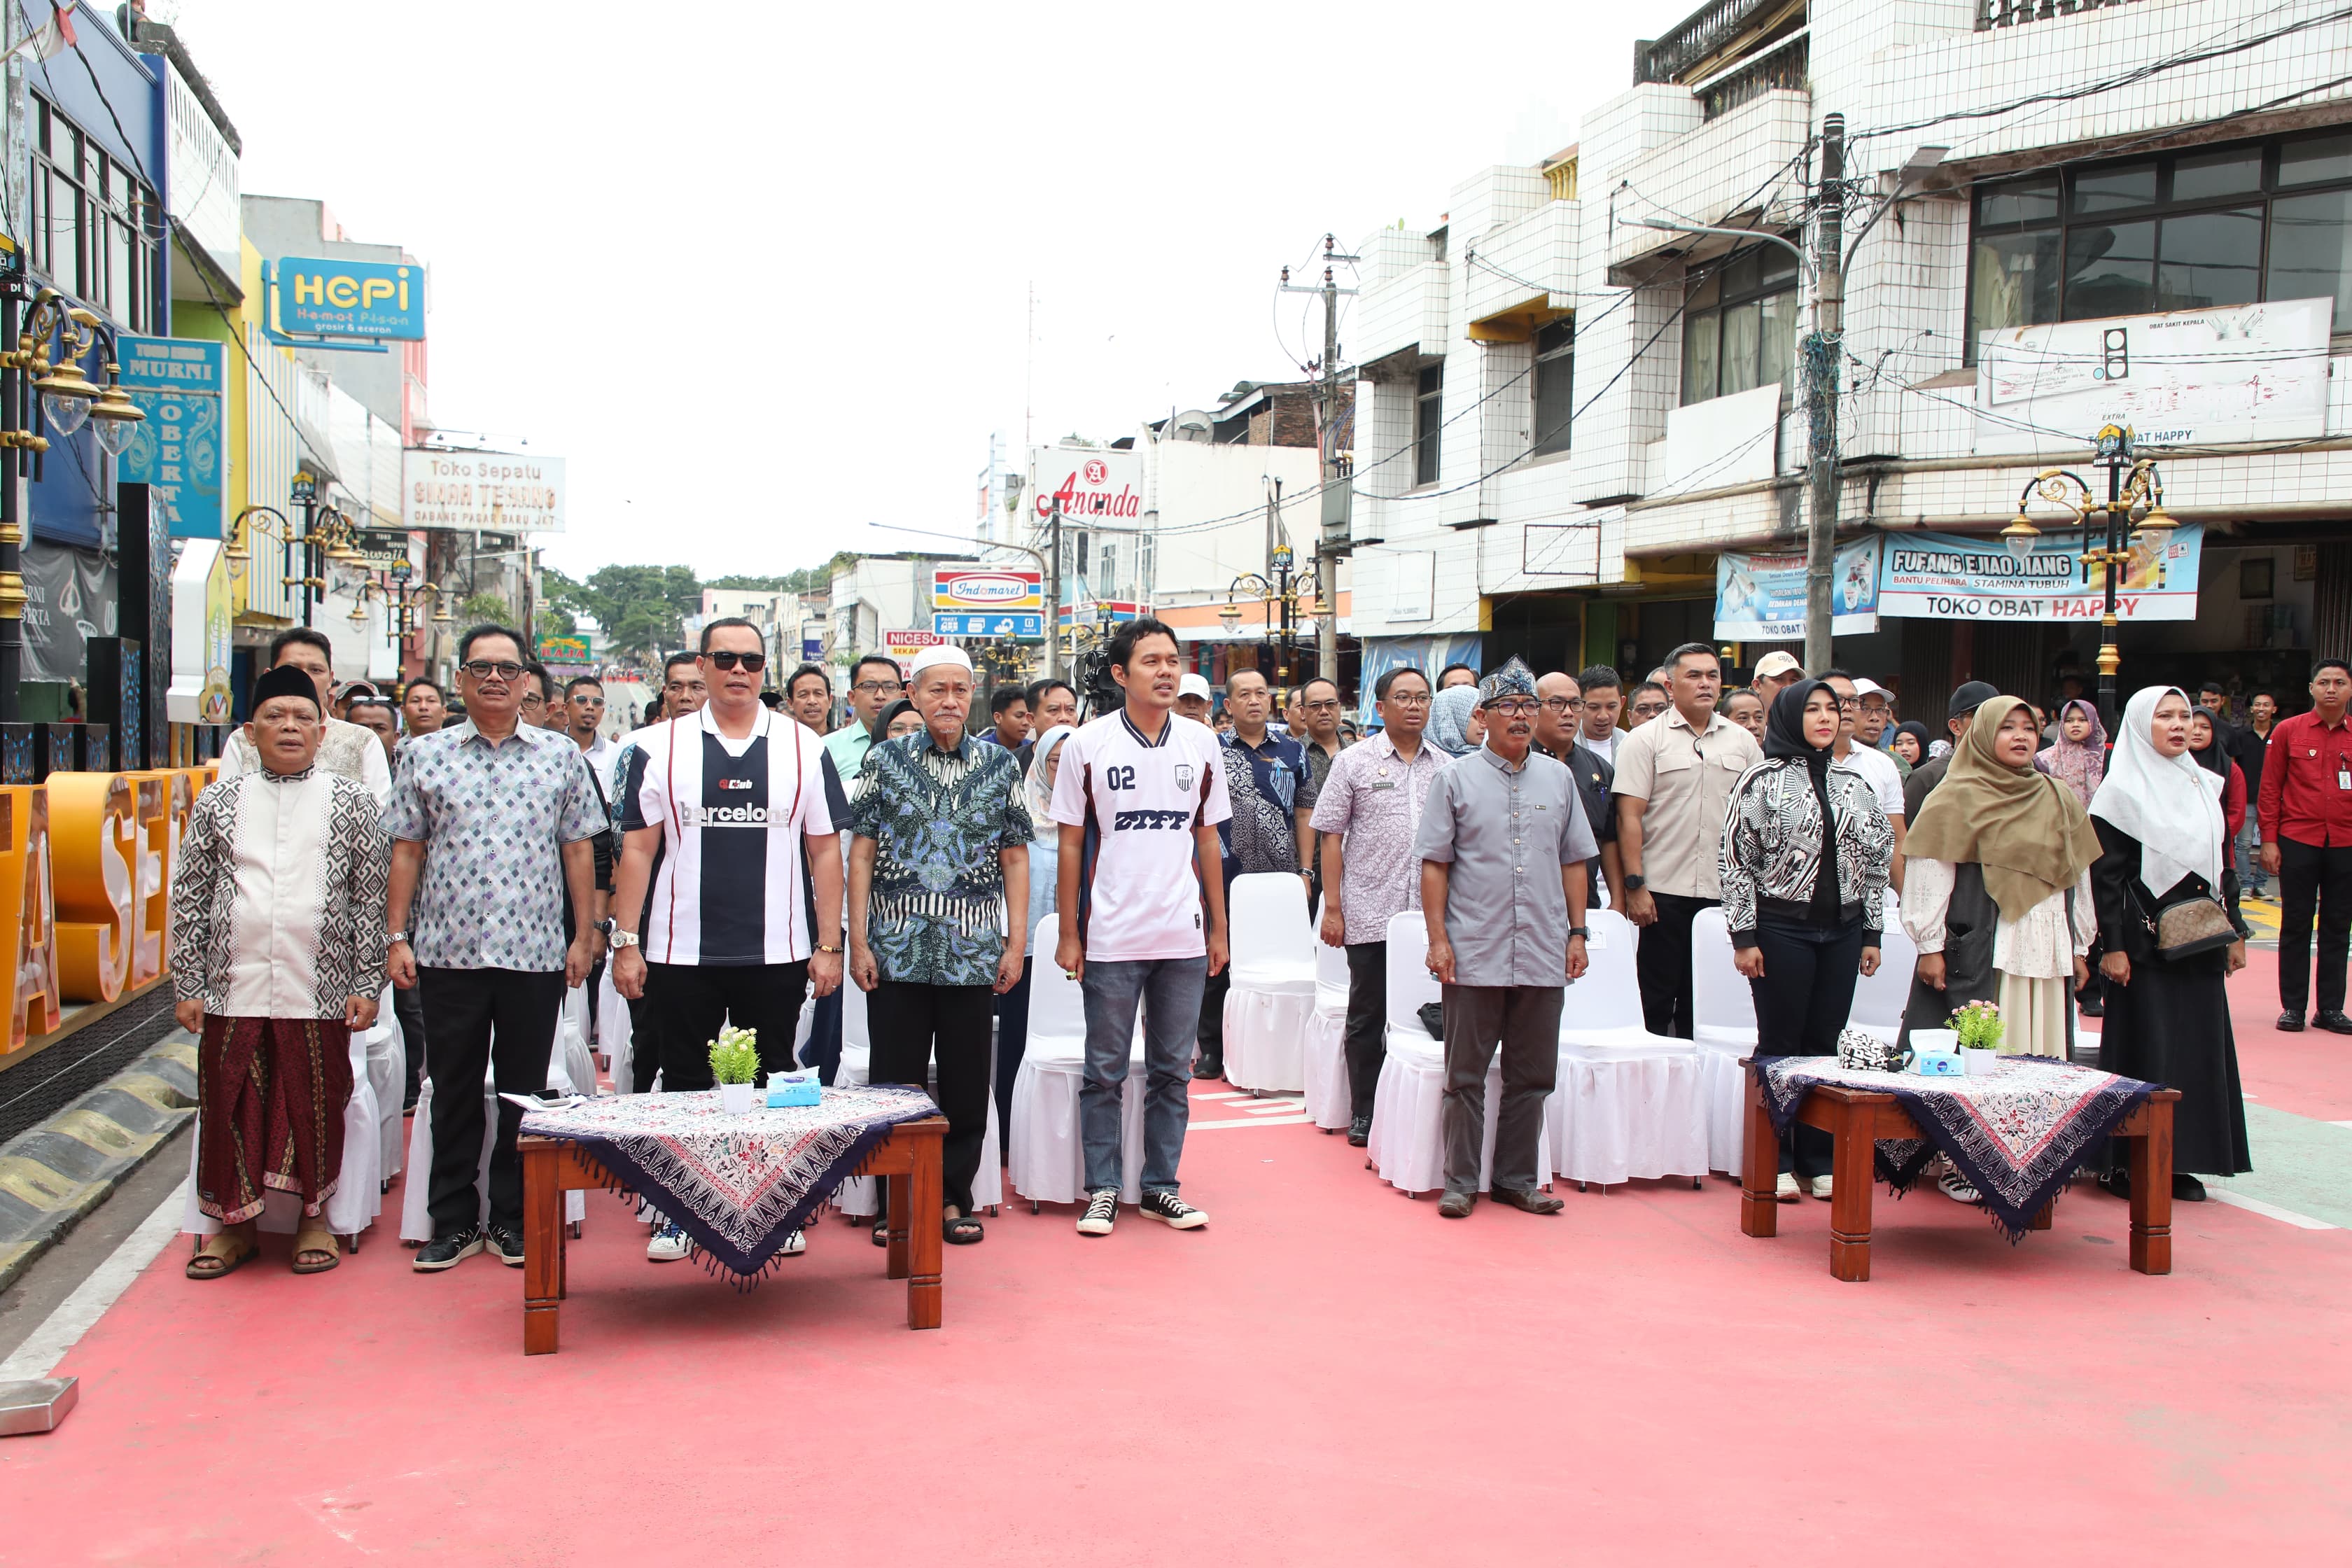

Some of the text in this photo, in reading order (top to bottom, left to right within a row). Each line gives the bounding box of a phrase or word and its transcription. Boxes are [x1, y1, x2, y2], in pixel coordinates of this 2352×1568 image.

[129, 359, 213, 381] MURNI
[2155, 430, 2192, 442] HAPPY
[431, 461, 541, 479] Toko Sepatu
[1036, 471, 1140, 517] Ananda
[502, 514, 529, 524] BARU
[535, 516, 554, 525] JKT
[1893, 550, 2071, 577] FUFANG EJIAO JIANG
[955, 582, 1021, 595] Indomaret
[1925, 577, 1967, 587] PELIHARA
[1974, 580, 2025, 589] STAMINA
[2028, 580, 2069, 589] TUBUH
[1927, 597, 1981, 615] TOKO
[1988, 600, 2043, 617] OBAT
[1762, 625, 1779, 635] TOKO
[1781, 624, 1800, 634] OBAT
[890, 633, 940, 645] NICESO
[541, 648, 585, 658] RAJA
[1107, 765, 1136, 791] 02
